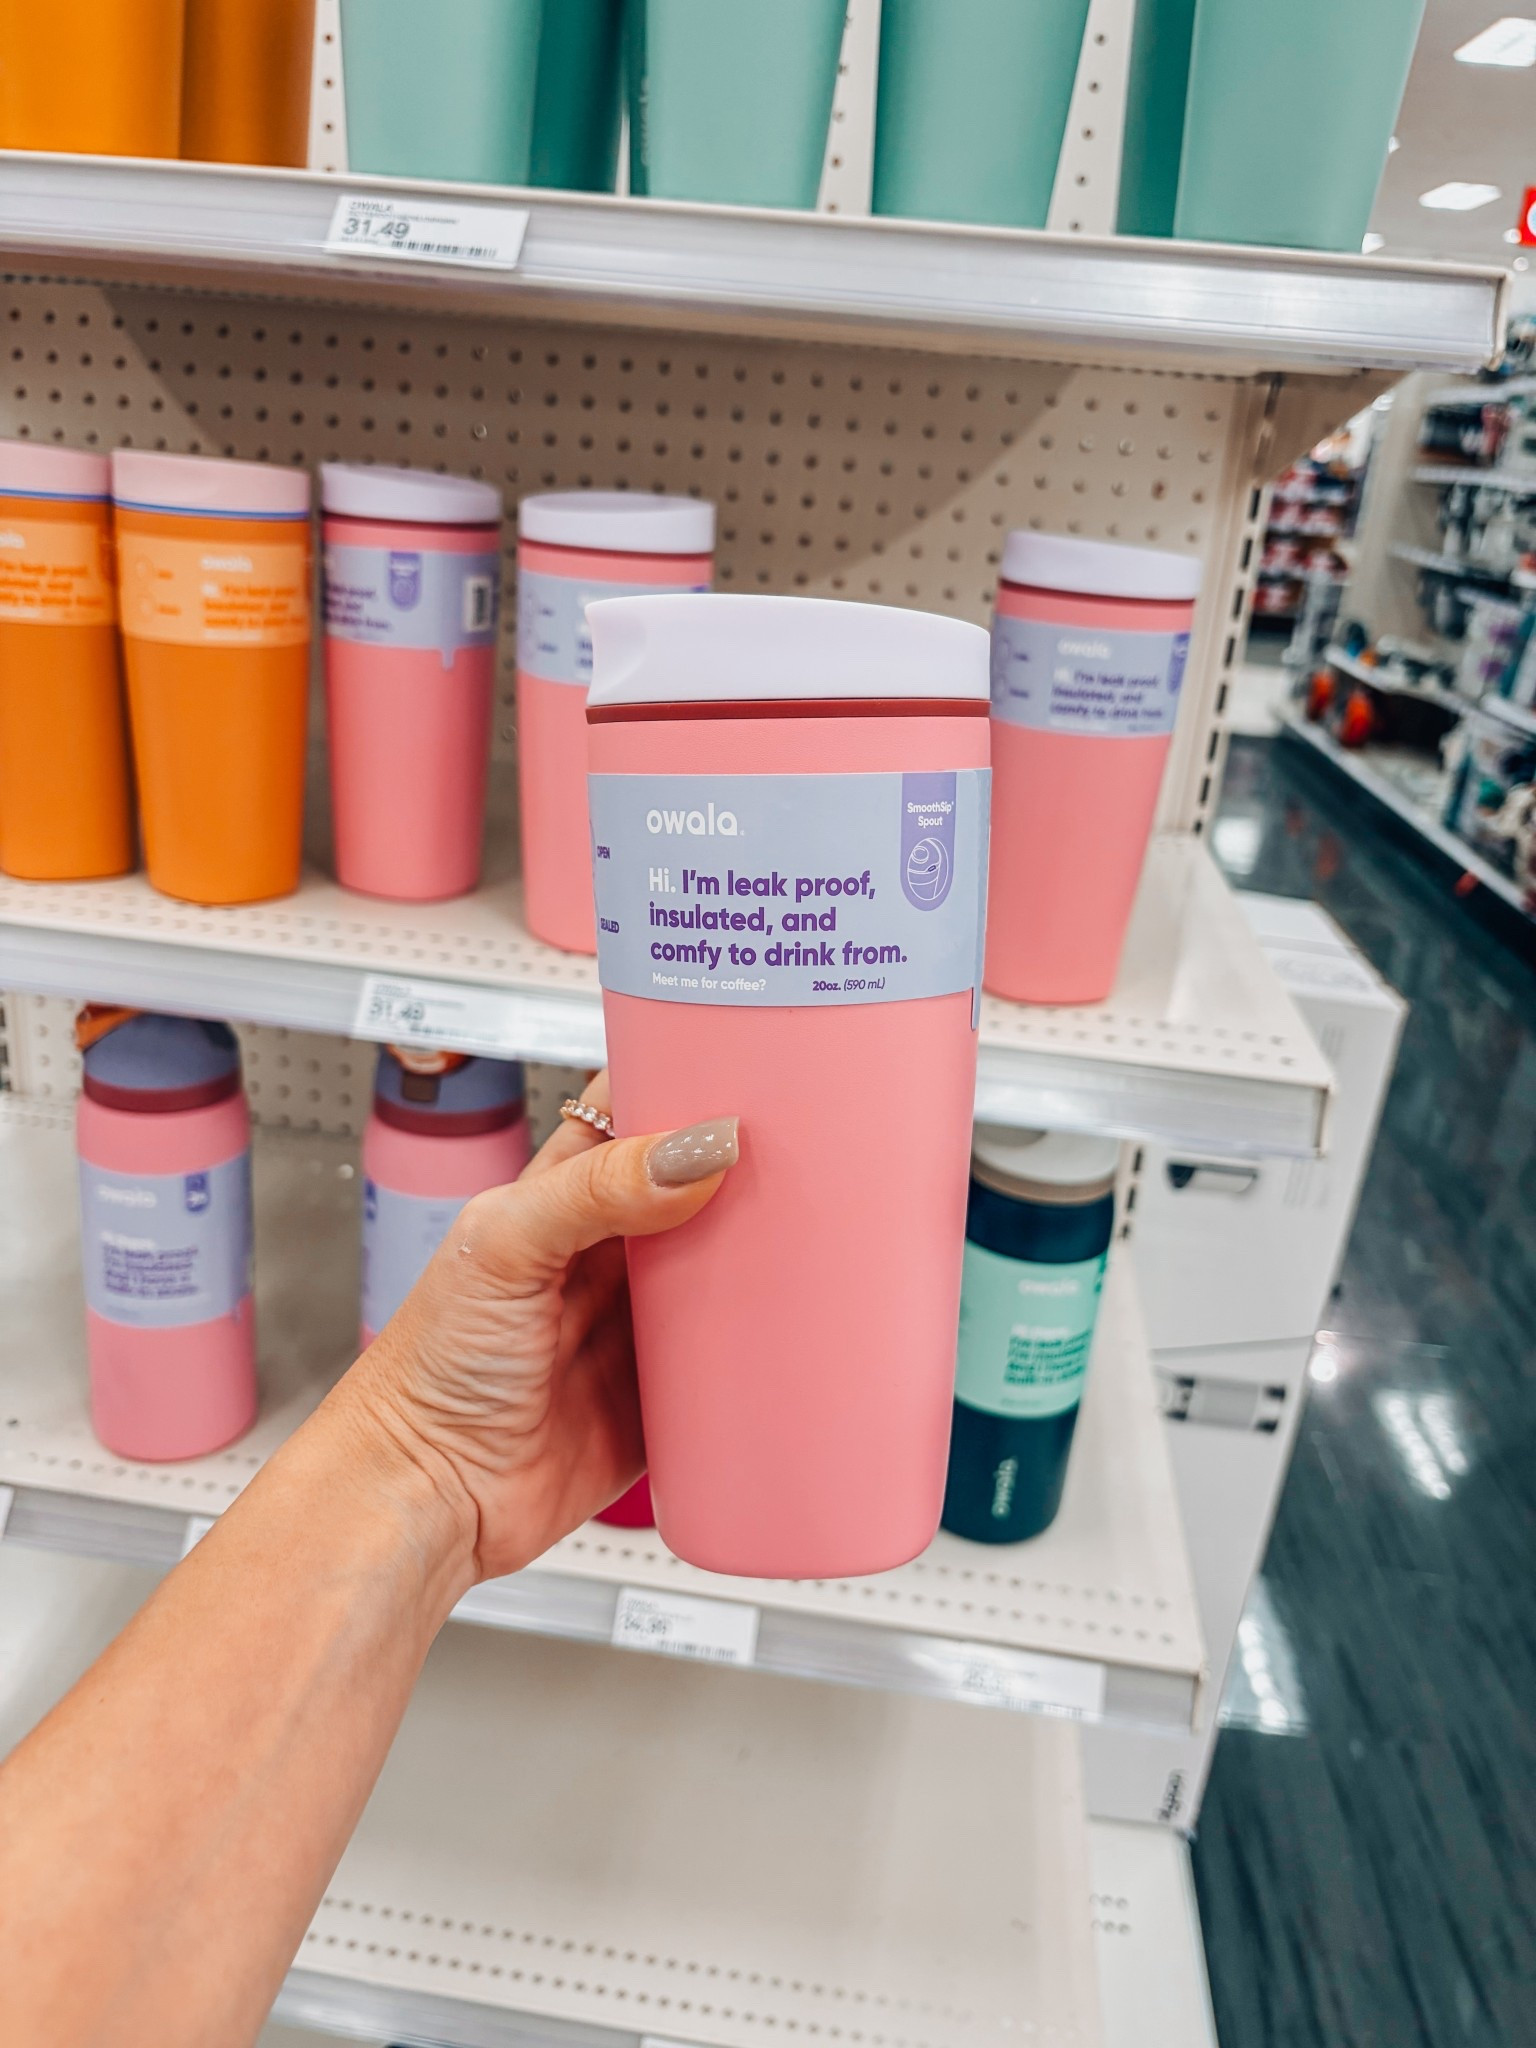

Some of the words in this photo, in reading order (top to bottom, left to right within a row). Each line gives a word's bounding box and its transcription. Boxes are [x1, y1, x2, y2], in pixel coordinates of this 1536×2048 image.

[343, 218, 410, 240] 31.49
[646, 802, 738, 836] owala
[917, 815, 943, 829] Spout
[597, 845, 611, 860] OPEN
[648, 867, 676, 893] Hi.
[682, 869, 720, 895] I'm
[727, 869, 788, 897] leak
[795, 870, 876, 903] proof,
[600, 917, 620, 934] SEALED
[649, 900, 774, 936] insulated,
[781, 906, 837, 932] and
[650, 939, 722, 970] comfy
[728, 943, 757, 966] to
[764, 941, 836, 967] drink
[842, 940, 908, 966] from.
[652, 972, 678, 986] Meet
[680, 976, 699, 988] me
[701, 976, 719, 989] for
[720, 978, 767, 991] coffee?
[812, 979, 841, 991] 20oz.
[843, 978, 866, 991] (590
[867, 976, 886, 990] mL)
